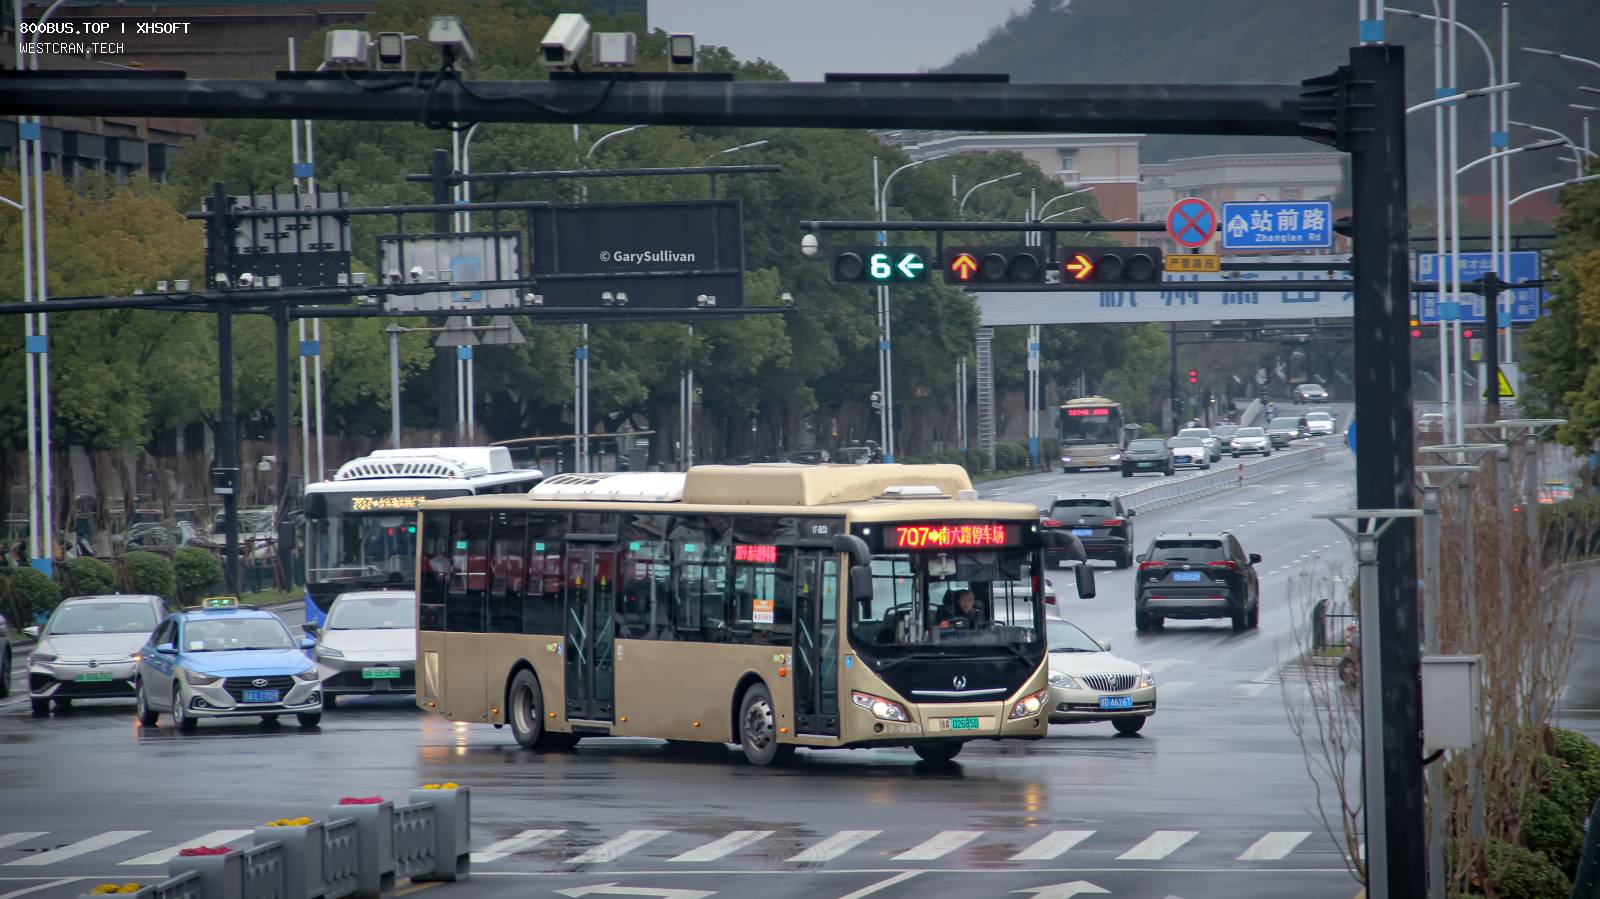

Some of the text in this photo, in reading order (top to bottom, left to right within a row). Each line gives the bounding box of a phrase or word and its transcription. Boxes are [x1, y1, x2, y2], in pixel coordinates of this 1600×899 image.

[1250, 208, 1325, 231] 站前路
[1255, 232, 1322, 243] Zhanqian Rd
[870, 253, 891, 279] 6
[897, 525, 1004, 546] 707 南六路停车场
